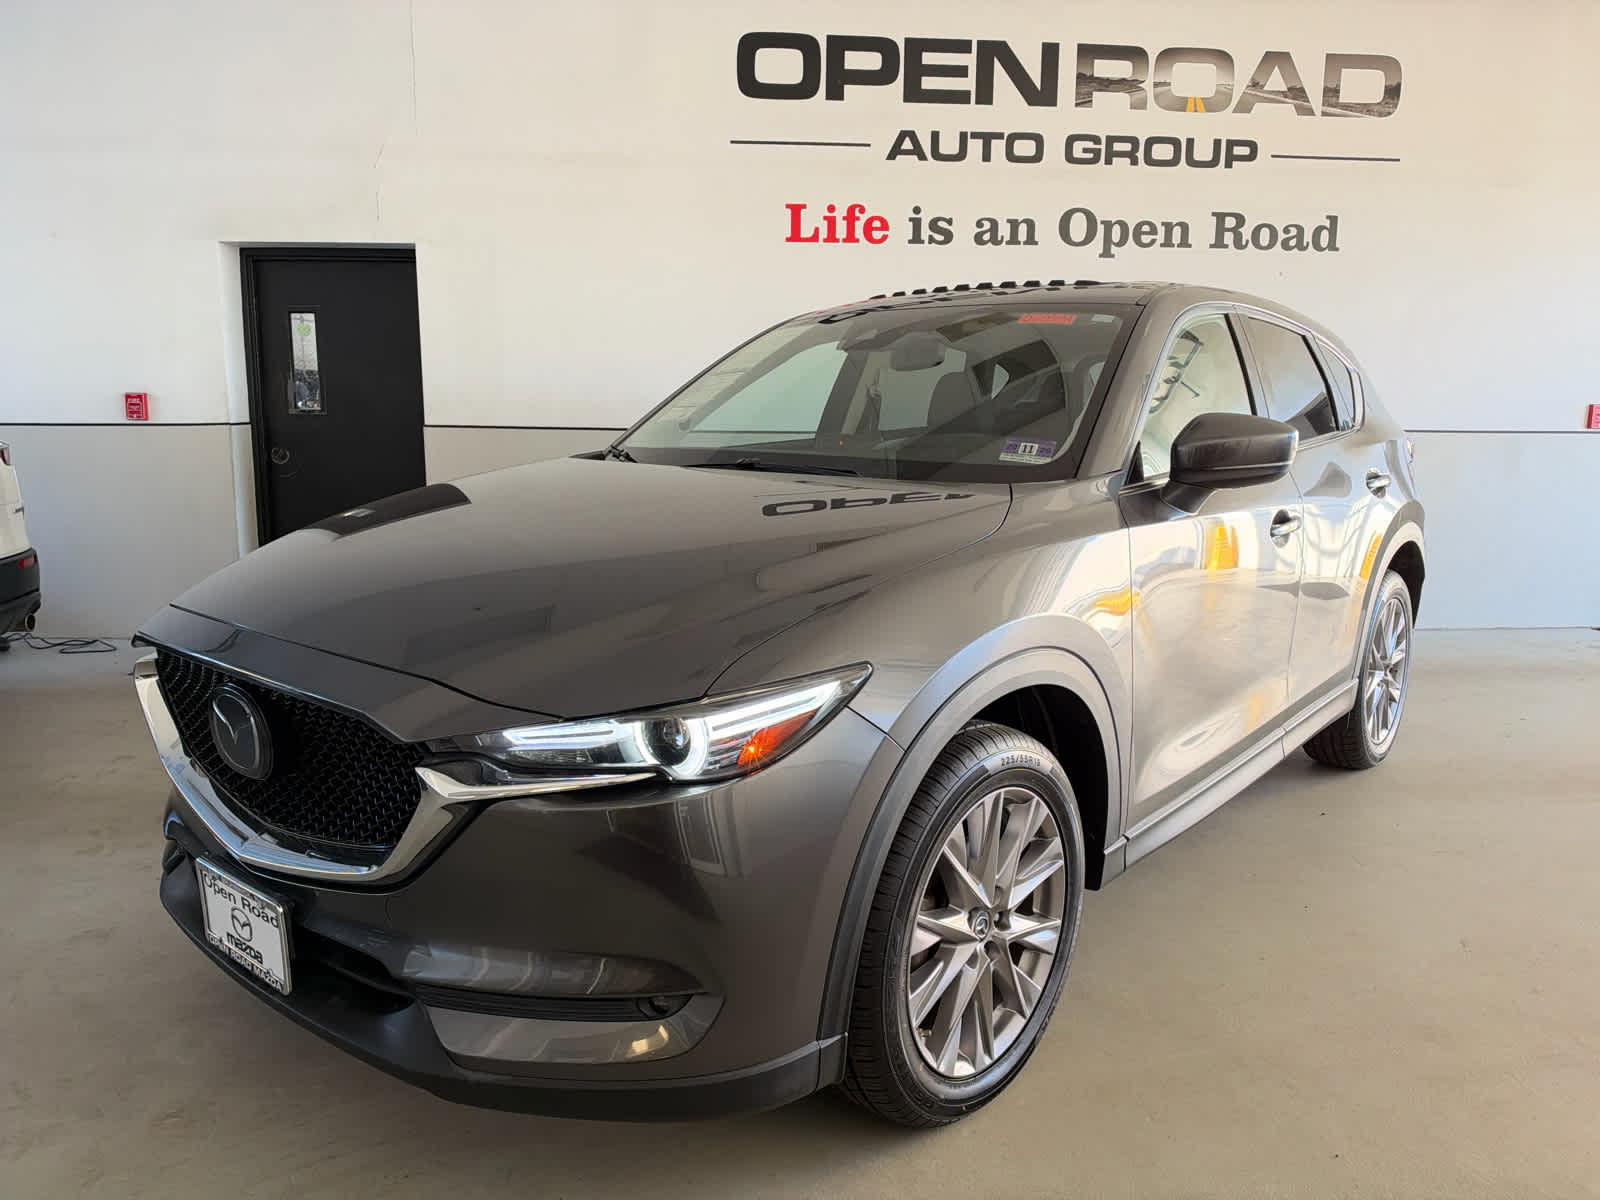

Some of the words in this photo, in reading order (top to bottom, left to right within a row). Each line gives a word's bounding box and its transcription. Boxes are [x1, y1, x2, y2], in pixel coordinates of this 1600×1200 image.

[736, 31, 1061, 108] OPEN
[1074, 42, 1403, 119] ROAD
[884, 129, 1045, 164] AUTO
[1064, 133, 1259, 169] GROUP
[785, 203, 890, 245] Life
[907, 205, 954, 246] is
[973, 217, 1039, 247] an
[1058, 207, 1193, 259] Open
[1208, 211, 1340, 253] Road
[203, 872, 237, 905] Open
[241, 898, 280, 929] Road
